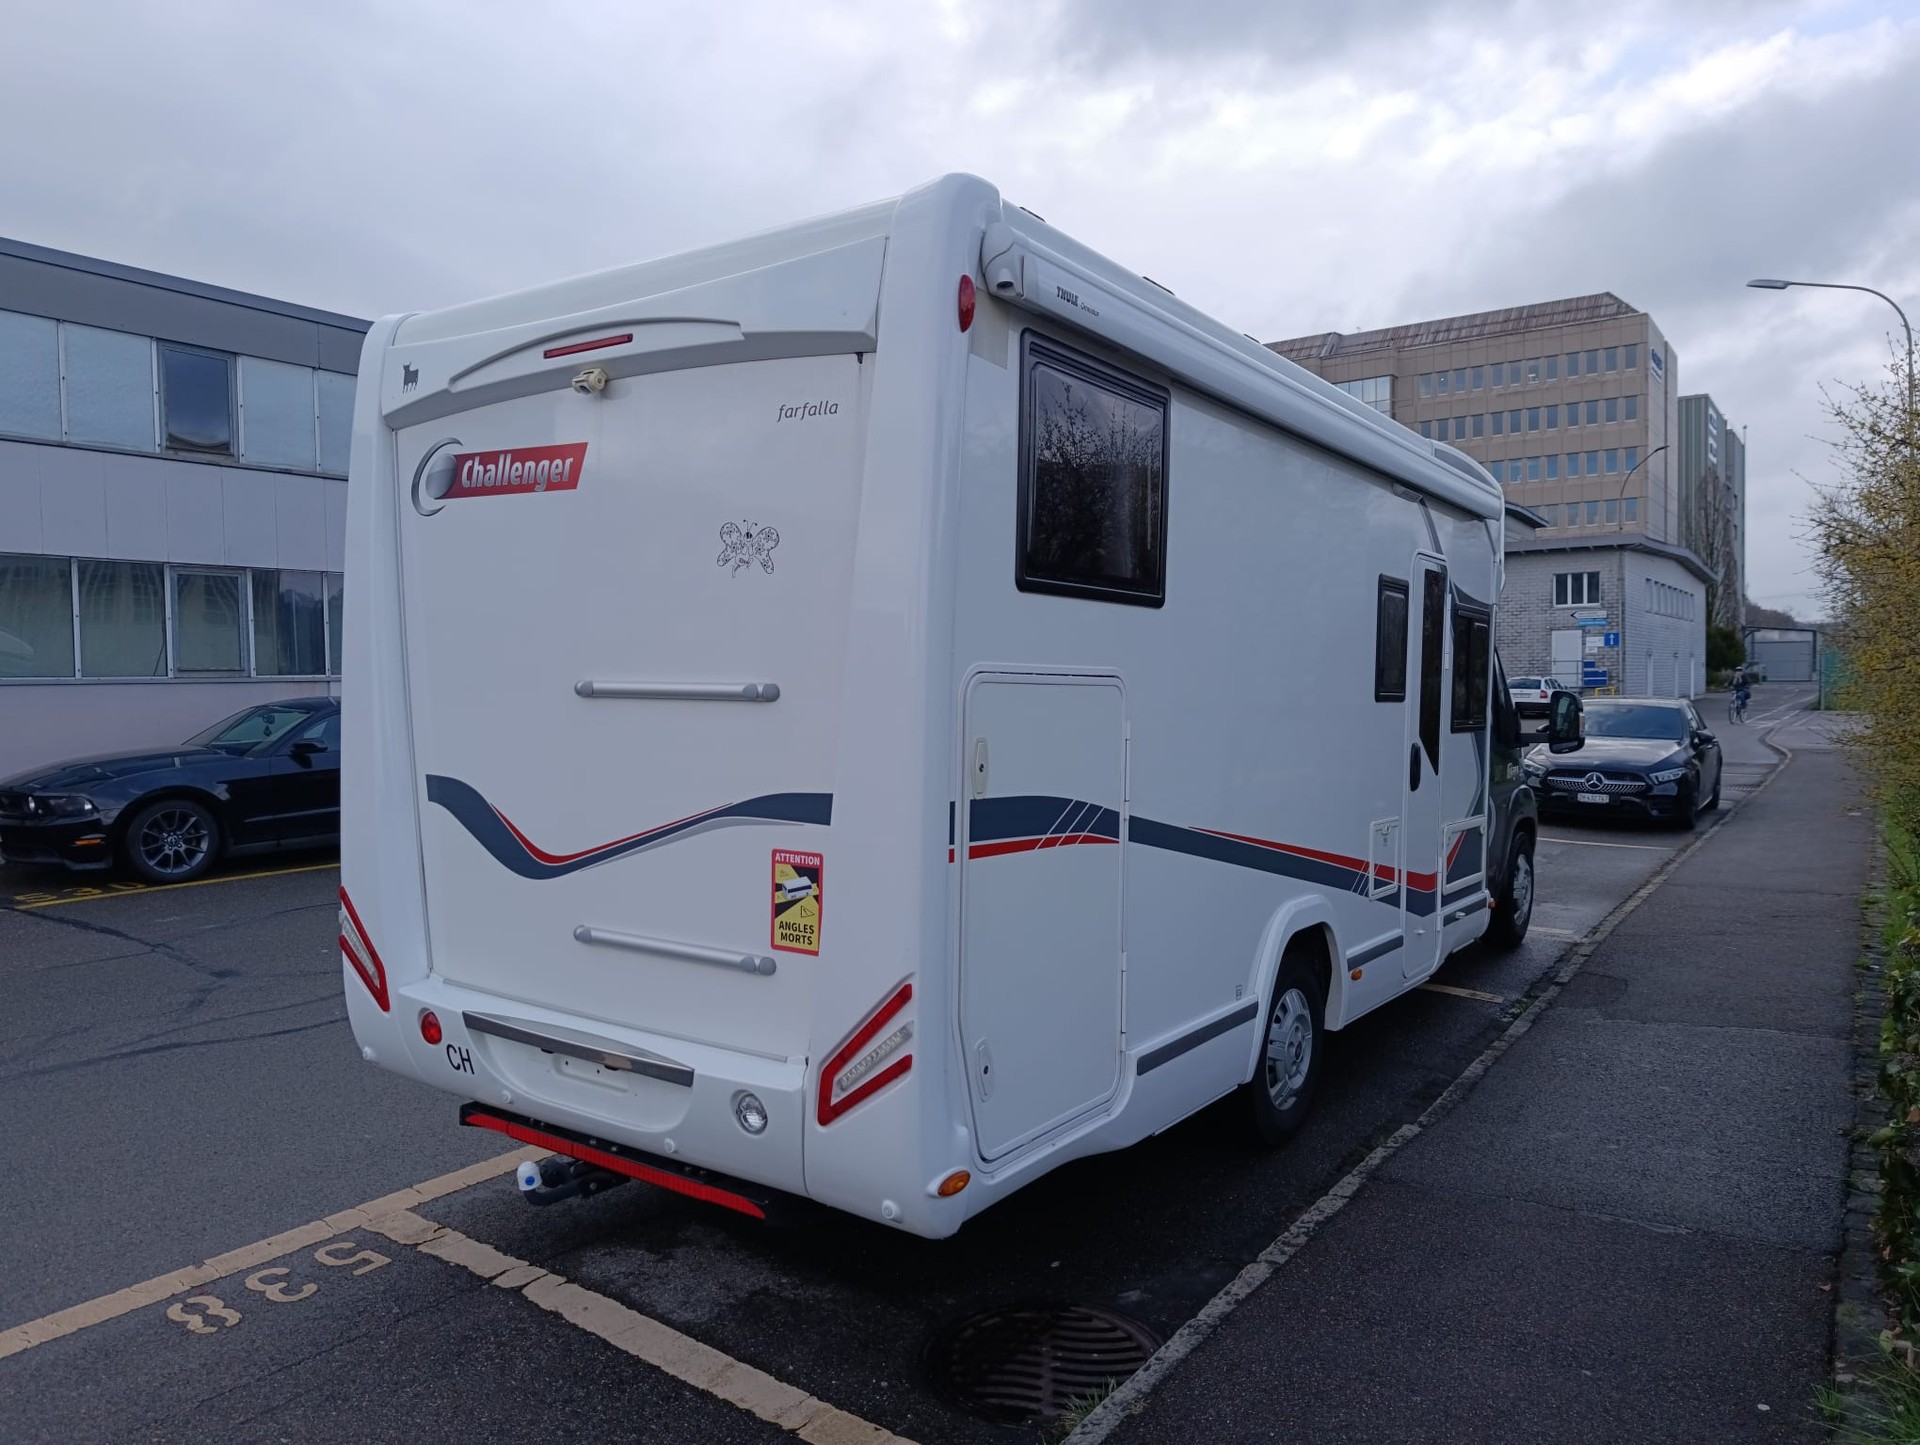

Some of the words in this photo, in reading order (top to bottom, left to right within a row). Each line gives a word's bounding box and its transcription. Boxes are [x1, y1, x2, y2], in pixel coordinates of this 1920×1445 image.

[1056, 285, 1079, 307] THULE
[777, 400, 839, 423] farfalla
[461, 453, 574, 492] Challenger
[775, 853, 820, 865] ATTENTION
[779, 921, 815, 934] ANGLES
[780, 932, 813, 945] MORTS
[446, 1043, 475, 1075] CH
